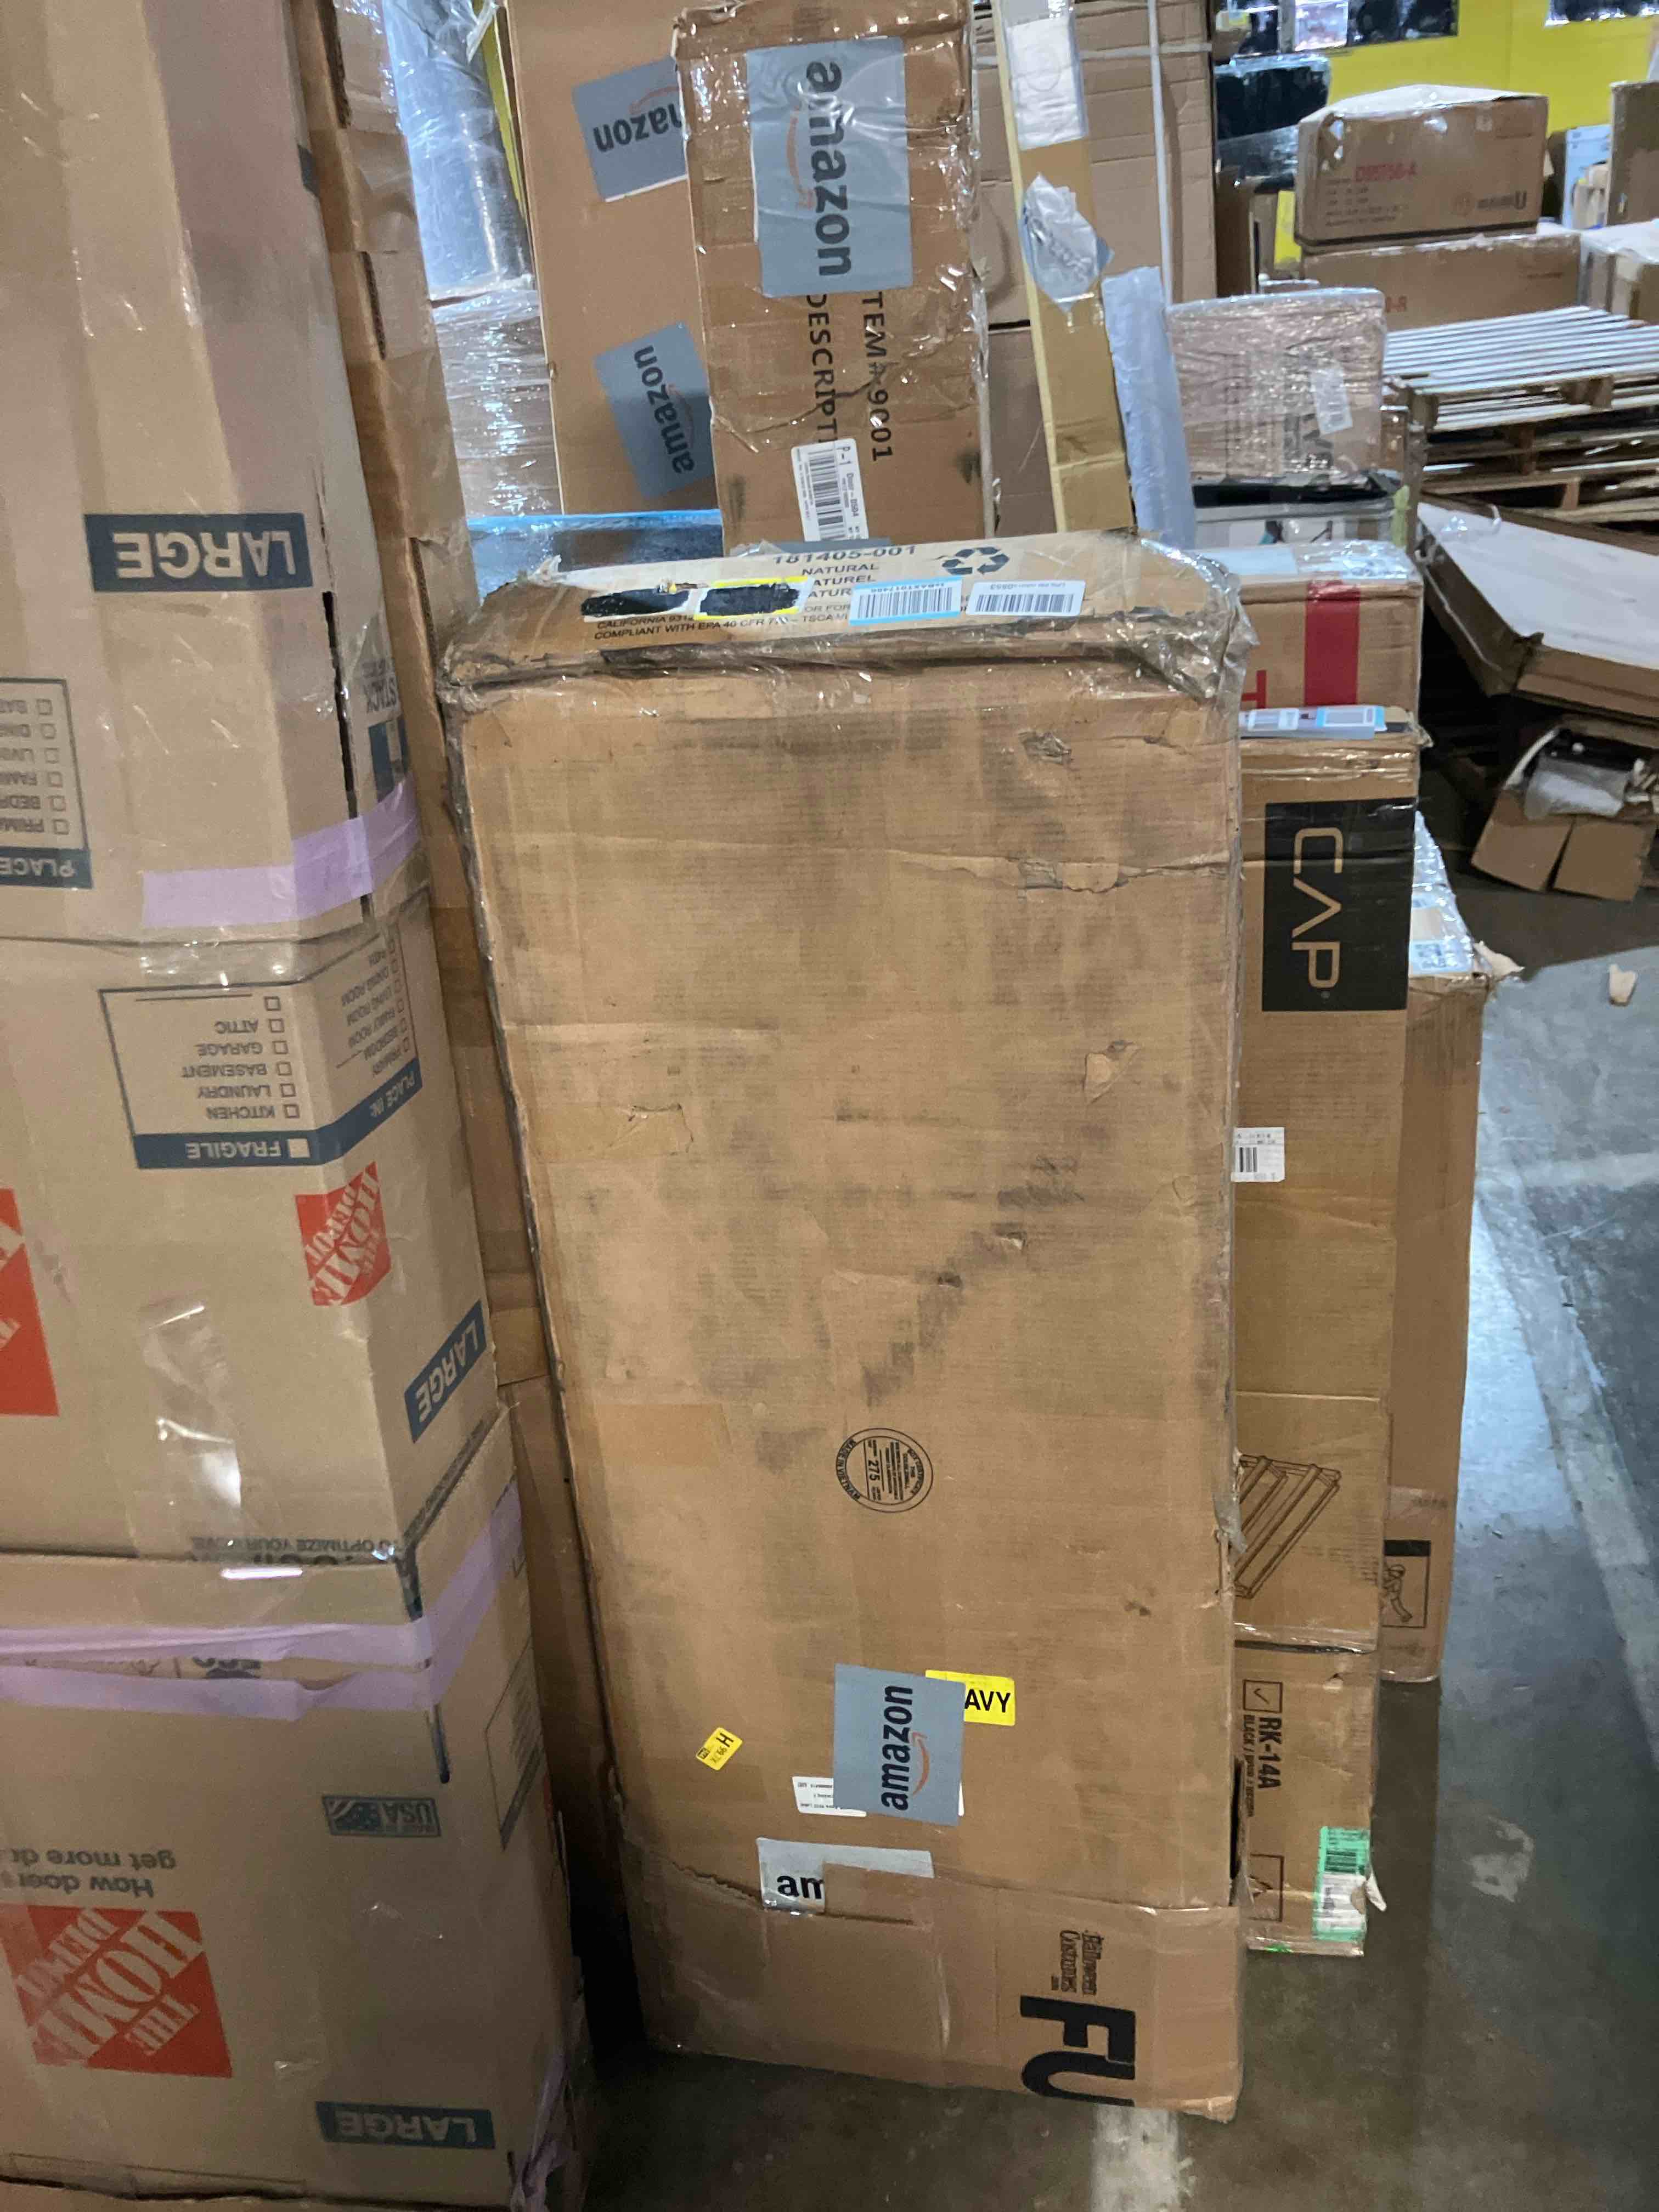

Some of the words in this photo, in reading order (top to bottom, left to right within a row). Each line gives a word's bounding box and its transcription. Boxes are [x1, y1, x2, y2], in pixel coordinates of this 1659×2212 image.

[592, 100, 683, 153] azon
[806, 60, 851, 277] amazon
[862, 291, 888, 379] TEM#
[807, 294, 838, 444] DESCRIPTI
[633, 345, 696, 474] amazon
[867, 390, 893, 462] 9001
[113, 530, 297, 579] LARGE
[772, 545, 917, 564] 181405-001
[802, 563, 879, 575] NATURAL
[813, 574, 877, 586] ATUREL
[808, 587, 851, 598] ATUR
[594, 626, 661, 640] COMPLIANT
[664, 623, 695, 633] WITH
[697, 621, 720, 630] EPA
[597, 616, 665, 630] CALIFORNIA
[0, 856, 76, 878] PLACE
[1290, 826, 1346, 989] CAP
[214, 1019, 259, 1035] ATTIC
[195, 1041, 263, 1057] GARAGE
[181, 1063, 267, 1078] BASEMENT
[198, 1084, 271, 1099] LAUNDRY
[206, 1105, 275, 1120] KITCHEN
[185, 1141, 281, 1159] FRAGILE
[414, 1322, 479, 1424] LARGE
[867, 1459, 881, 1481] 275
[296, 1539, 374, 1553] OPTIMIZE
[964, 1688, 1011, 1713] AVY
[715, 1732, 735, 1748] H
[1243, 1714, 1256, 1744] BLACK
[881, 1685, 913, 1812] amazon
[1257, 1717, 1283, 1789] RK-14A
[379, 1800, 436, 1826] USA
[47, 1849, 121, 1867] more
[128, 1849, 177, 1871] get
[89, 1874, 154, 1898] How
[776, 1875, 825, 1900] am
[124, 1994, 200, 2056] THE
[336, 2110, 478, 2144] LARGE
